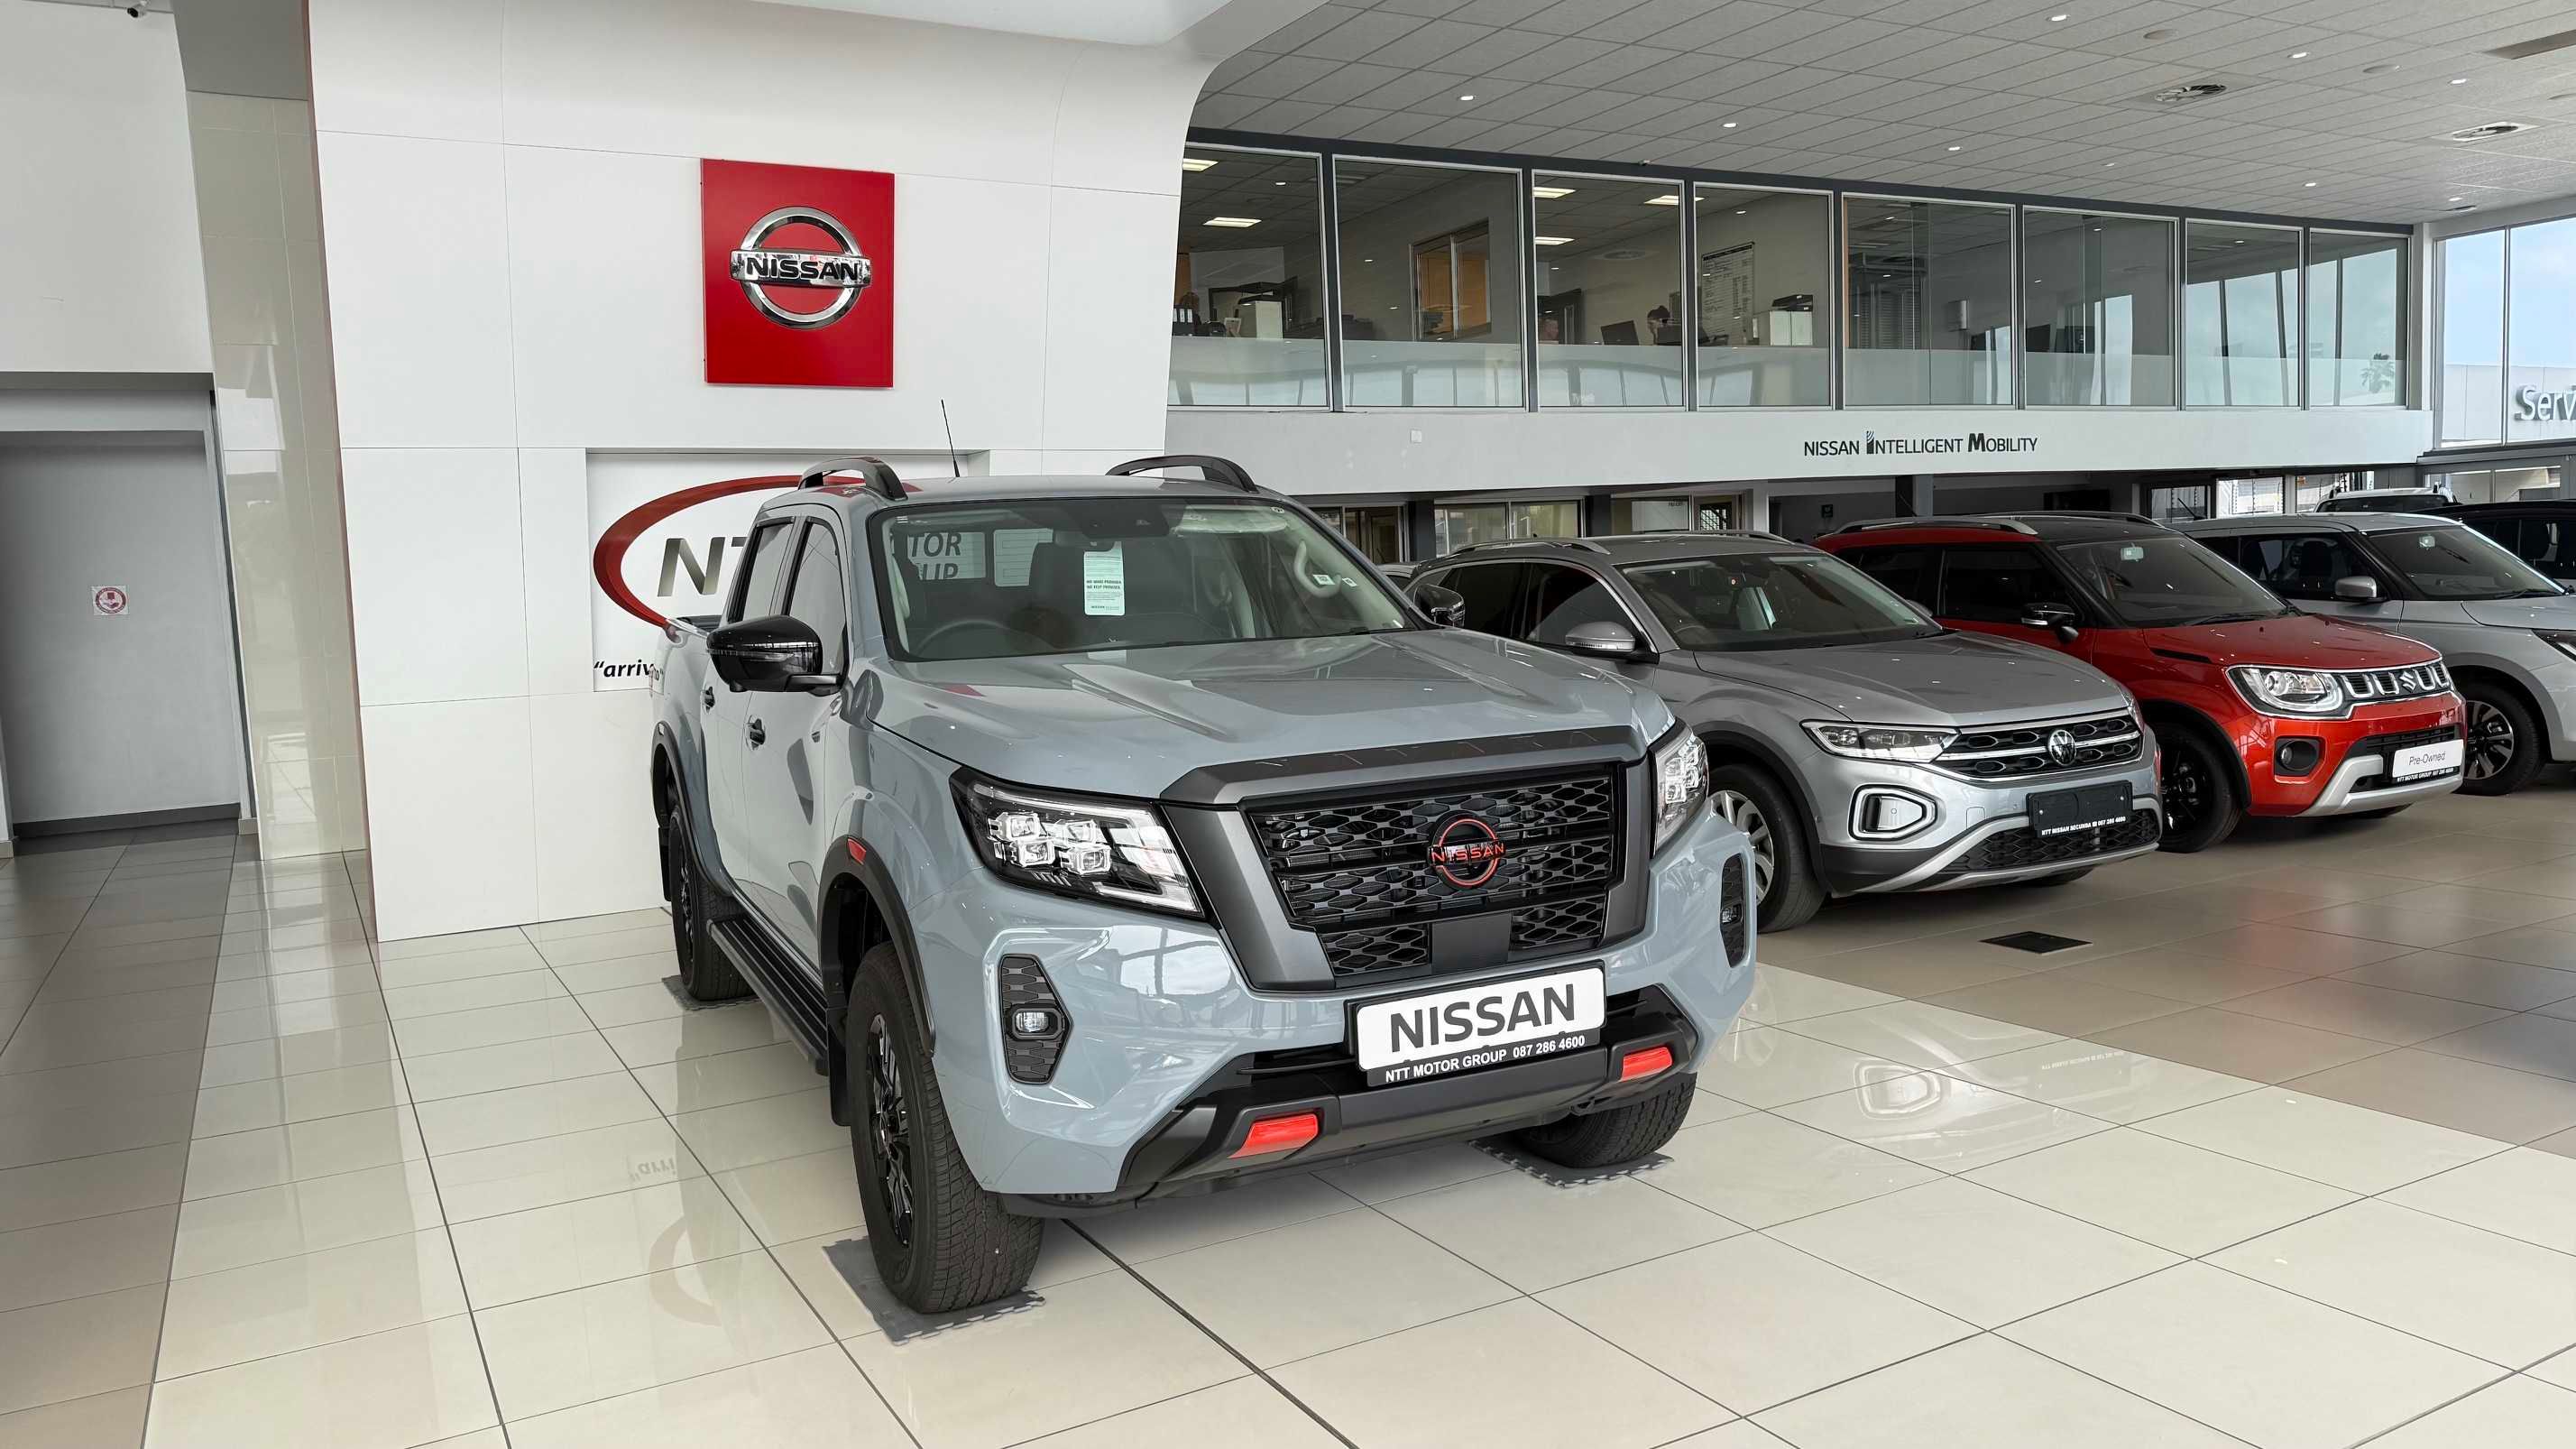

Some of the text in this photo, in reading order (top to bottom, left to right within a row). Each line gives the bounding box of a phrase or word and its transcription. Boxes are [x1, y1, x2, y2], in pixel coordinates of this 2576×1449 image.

[746, 257, 860, 281] NISSAN
[1804, 430, 2038, 456] NISSAN INTELLIGENT MOBILITY
[2408, 751, 2446, 766] Pre-Owned
[2052, 826, 2069, 834] NISSAN
[1431, 842, 1504, 862] NISSAN
[1390, 983, 1575, 1053] NISSAN
[1385, 1035, 1586, 1083] NTT MOTOR GROUP 087 286 4600
